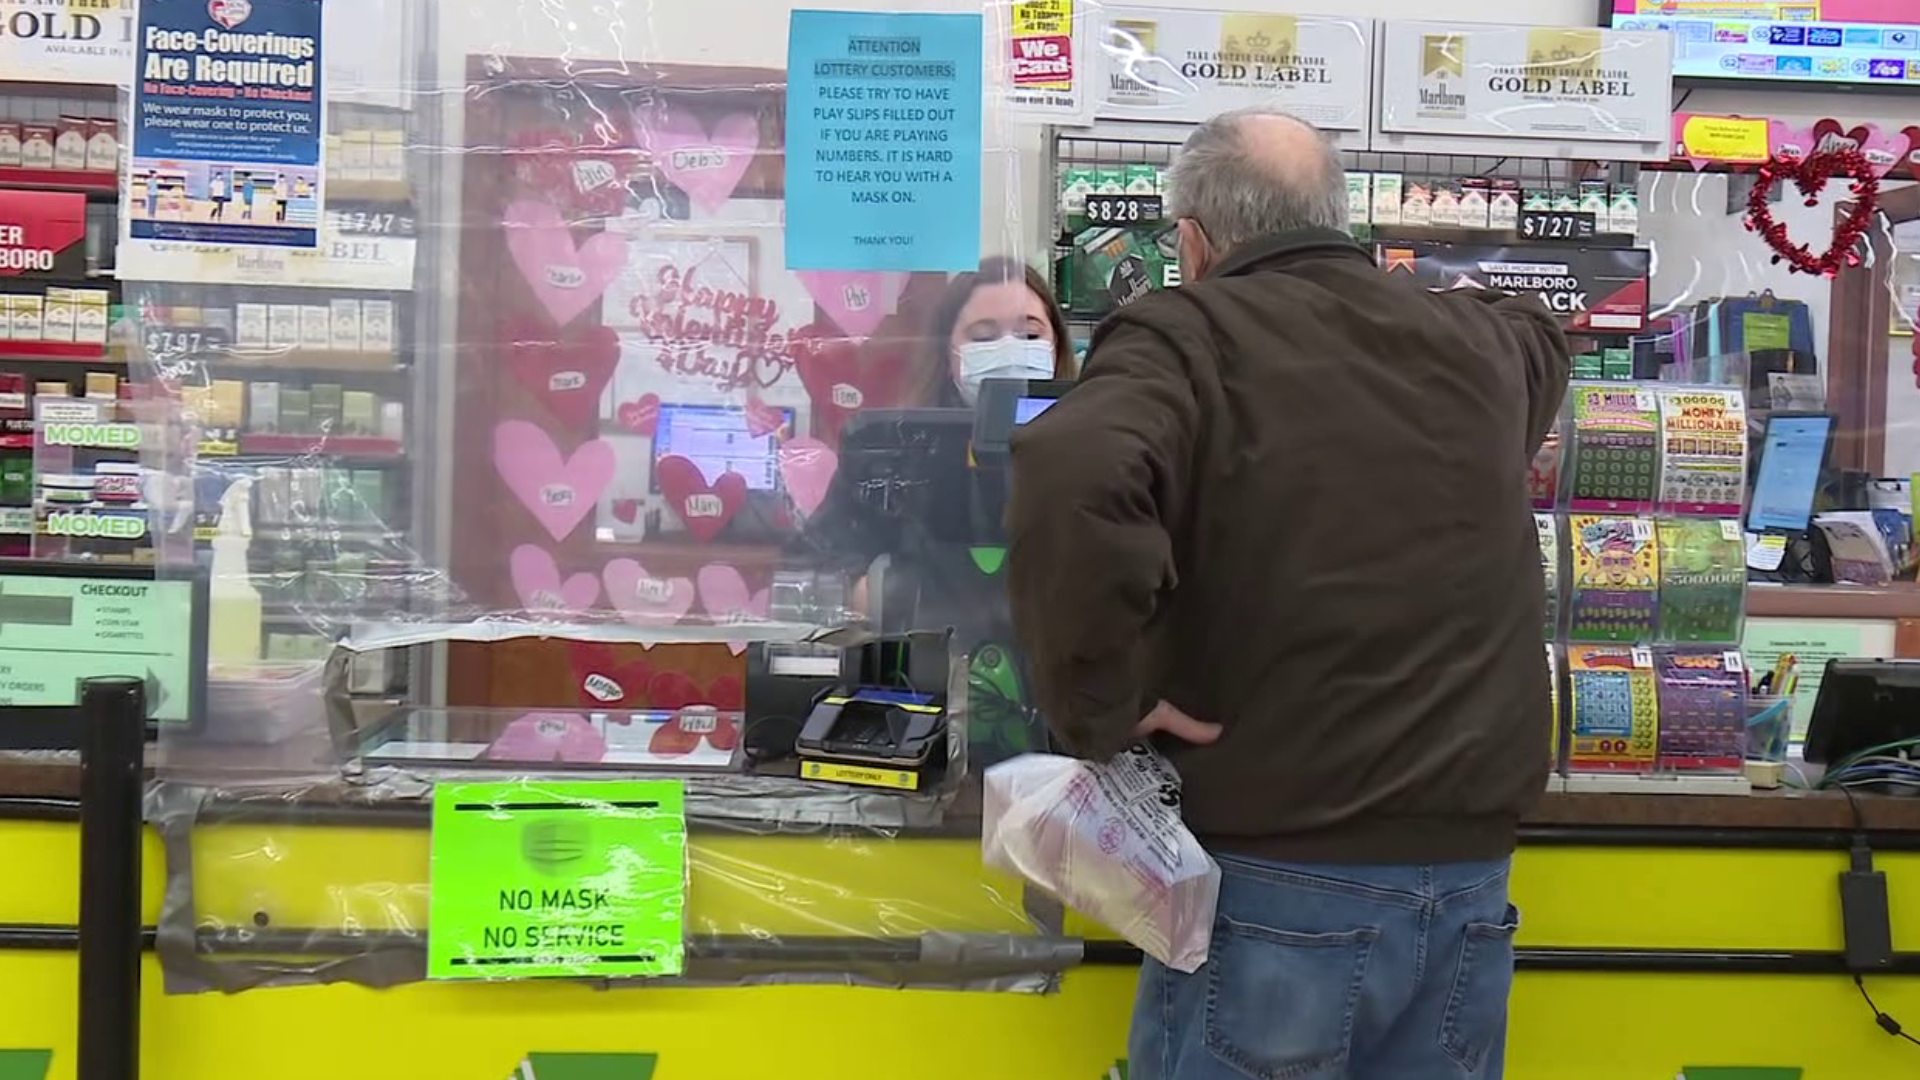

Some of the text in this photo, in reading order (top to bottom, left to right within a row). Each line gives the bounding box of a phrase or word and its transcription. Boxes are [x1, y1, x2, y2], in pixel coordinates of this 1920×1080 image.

[145, 26, 315, 59] Face-Coverings
[848, 39, 921, 54] ATTENTION
[1019, 39, 1060, 57] We
[144, 52, 314, 87] Are Required
[814, 63, 956, 78] LOTTERY CUSTOMERS:
[1014, 56, 1069, 75] Card
[1181, 62, 1332, 84] GOLD LABEL
[819, 86, 950, 100] PLEASE TRY TO HAVE
[1419, 82, 1466, 106] Marlboro
[1488, 77, 1635, 97] GOLD LABEL
[143, 103, 161, 114] We
[164, 106, 190, 115] wear
[193, 106, 227, 117] masks
[230, 107, 240, 117] to
[243, 108, 284, 120] protect
[814, 107, 955, 121] PLAY SLIPS FILLED OUT
[144, 116, 311, 134] please wear one to protect us.
[820, 129, 949, 142] IF YOU ARE PLAYING
[816, 150, 953, 163] NUMBERS. IT IS HARD
[816, 170, 953, 183] TO HEAR YOU WITH A
[852, 192, 916, 203] MASK ON.
[854, 236, 914, 246] THANK YOU!
[1487, 264, 1510, 273] SAVE
[1512, 264, 1537, 273] MORE
[1489, 275, 1578, 291] MARLBORO
[657, 265, 780, 332] Happy
[1604, 392, 1637, 406] MILLIO
[1682, 407, 1725, 418] MONEY
[1667, 418, 1743, 432] MILLIONAIRE
[46, 425, 140, 446] MOMED
[50, 515, 143, 536] MOMED
[80, 583, 148, 598] CHECKOUT
[101, 606, 132, 615] STAMPS
[101, 631, 144, 640] CIGARETTES
[8, 682, 45, 693] ORDERS
[500, 889, 610, 911] NO MASK
[484, 925, 625, 948] NO SERVICE
